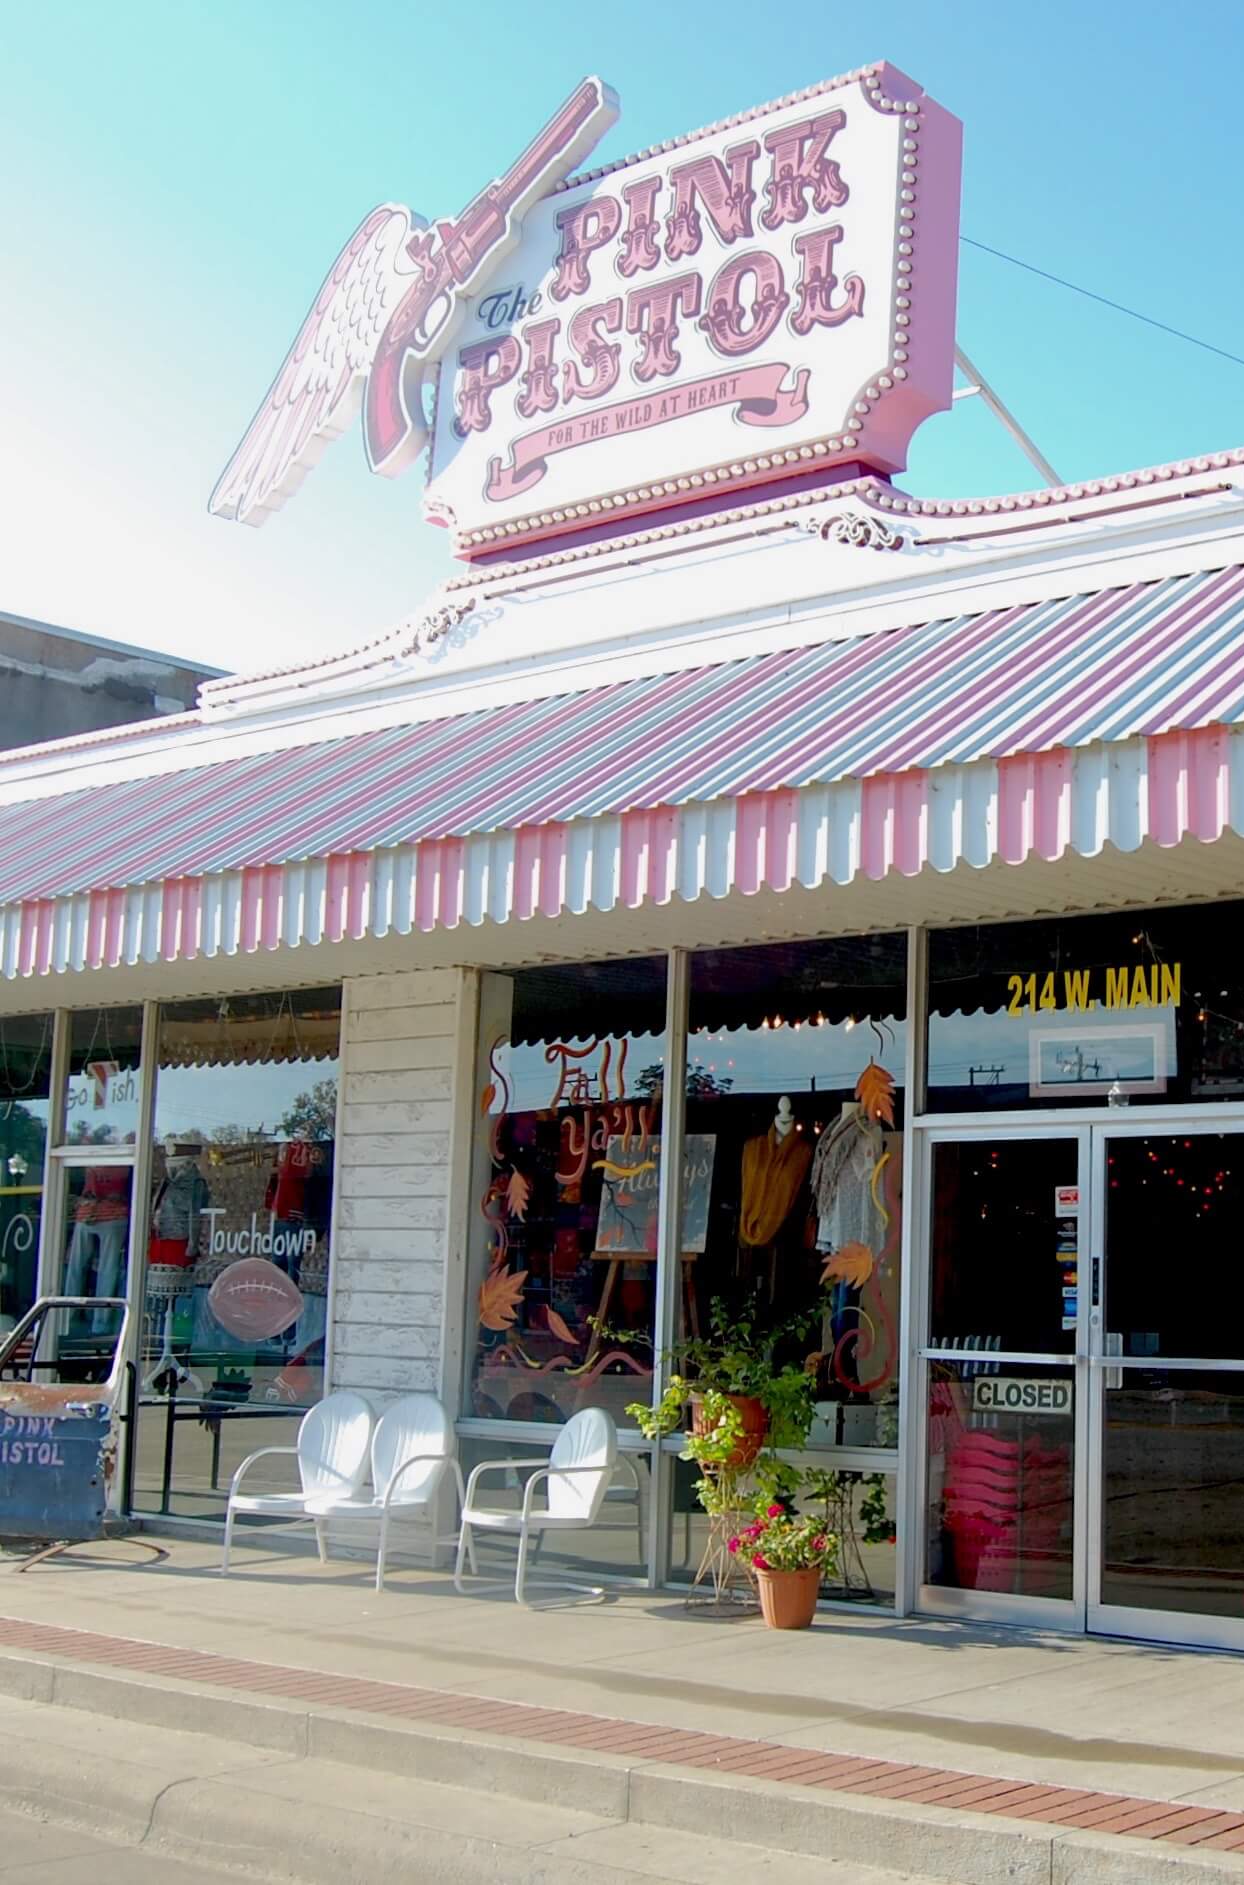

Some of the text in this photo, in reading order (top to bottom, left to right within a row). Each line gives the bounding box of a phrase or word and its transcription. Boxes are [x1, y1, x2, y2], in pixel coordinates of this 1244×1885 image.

[552, 108, 850, 301] PINK
[453, 225, 865, 436] PISTOL
[477, 286, 542, 331] The
[547, 377, 741, 447] FOR THE WILD AT HEART
[1007, 962, 1181, 1018] 214 W. MAIN
[545, 1038, 628, 1121] Fall
[199, 1207, 317, 1257] Touchdown
[976, 1381, 1069, 1409] CLOSED
[0, 1416, 55, 1438] PINK
[0, 1440, 65, 1466] ISTOL
